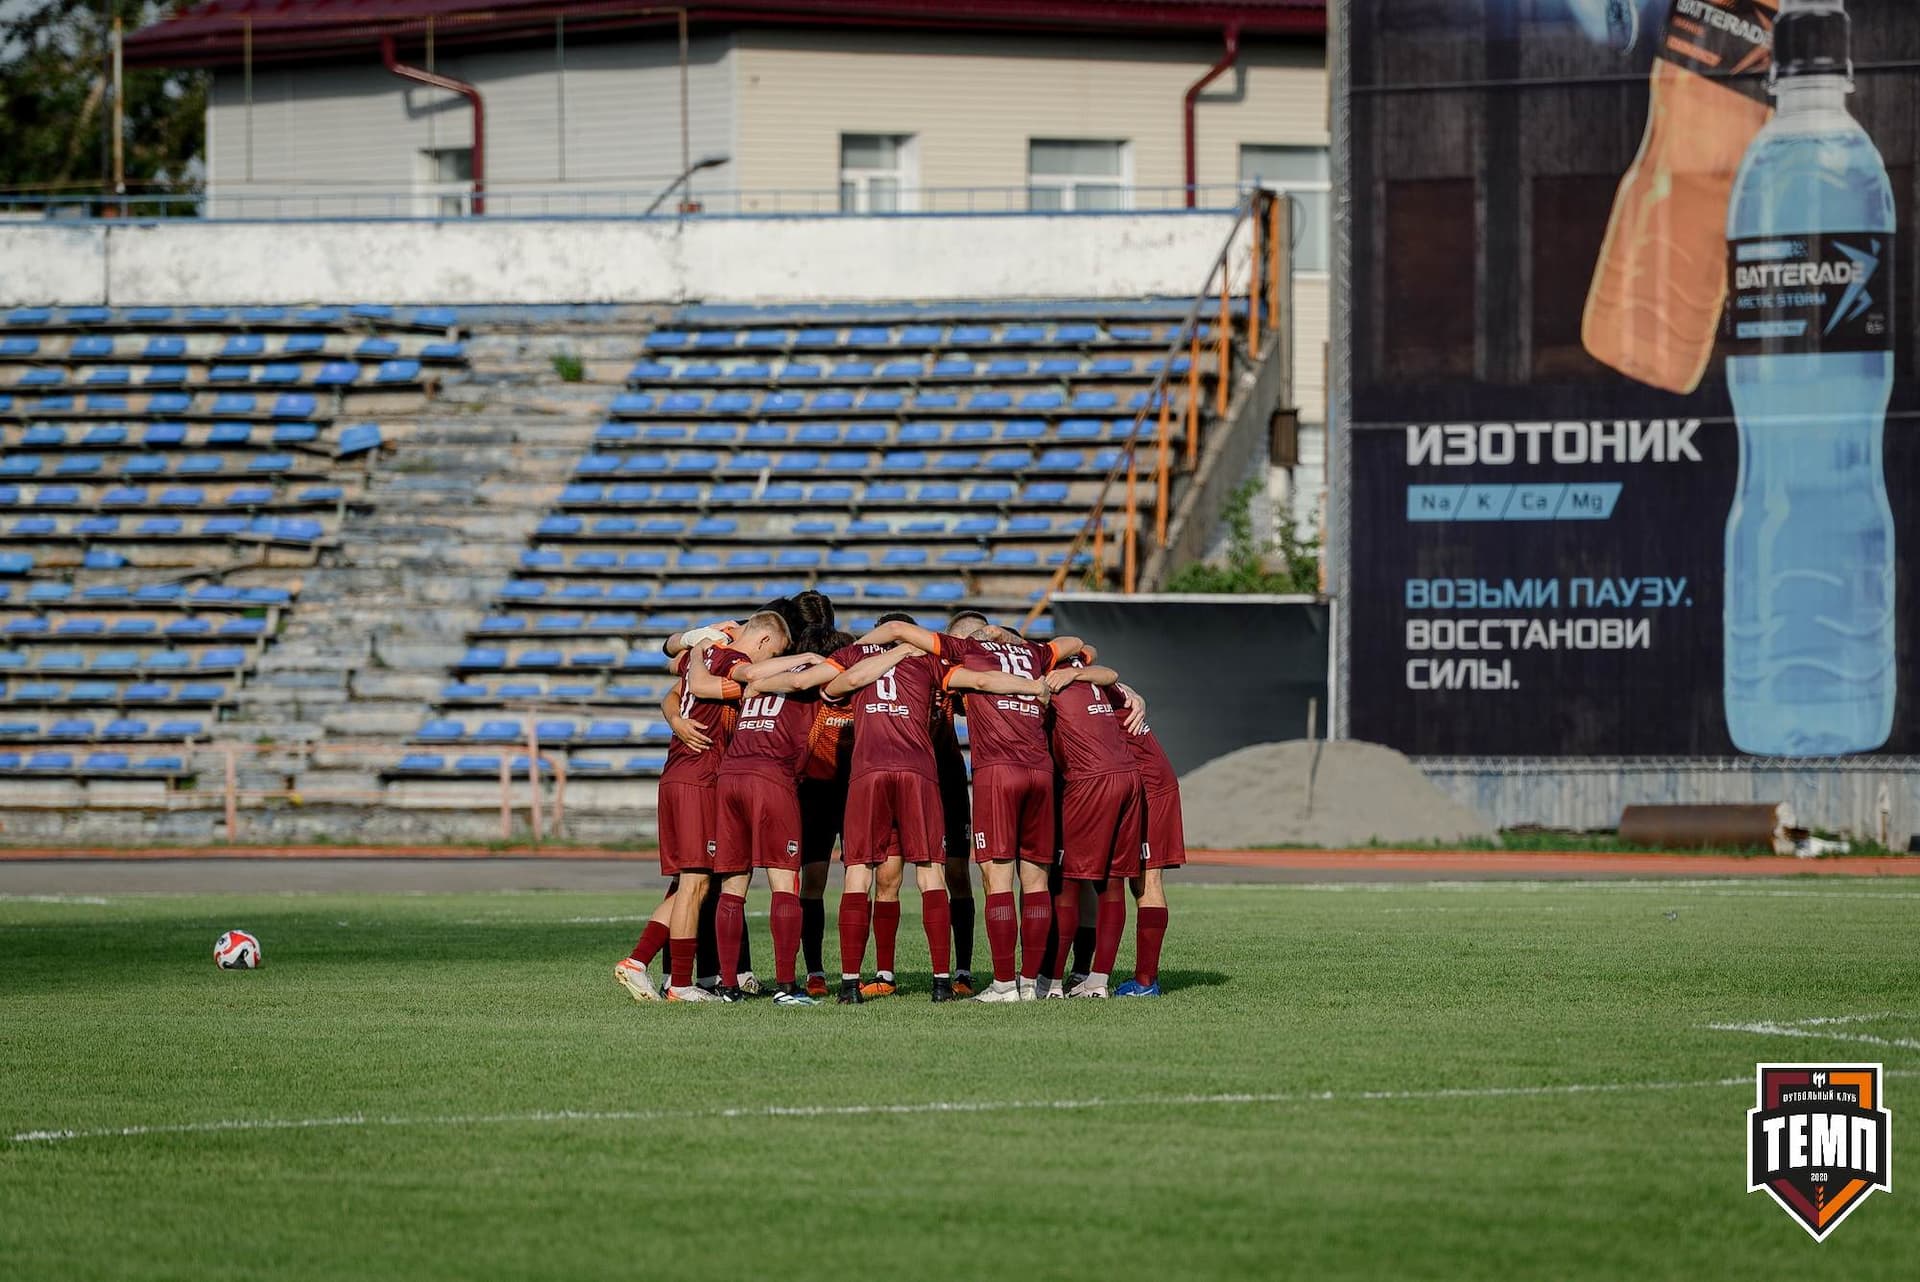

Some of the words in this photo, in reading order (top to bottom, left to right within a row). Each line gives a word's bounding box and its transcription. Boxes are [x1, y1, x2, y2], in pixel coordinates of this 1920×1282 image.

[1406, 419, 1703, 466] ИЗОТОНИК
[1421, 494, 1450, 511] Na
[1572, 493, 1604, 513] Mg
[1406, 579, 1559, 609] ВОЗЬМИ
[1570, 577, 1693, 608] ПАУЗУ.
[1406, 618, 1651, 650] ВОССТАНОВИ
[1406, 658, 1520, 690] СИЛЫ.
[865, 703, 910, 716] SEUS
[994, 699, 1040, 716] SEUS
[738, 719, 776, 731] SEUS
[975, 831, 987, 850] 15
